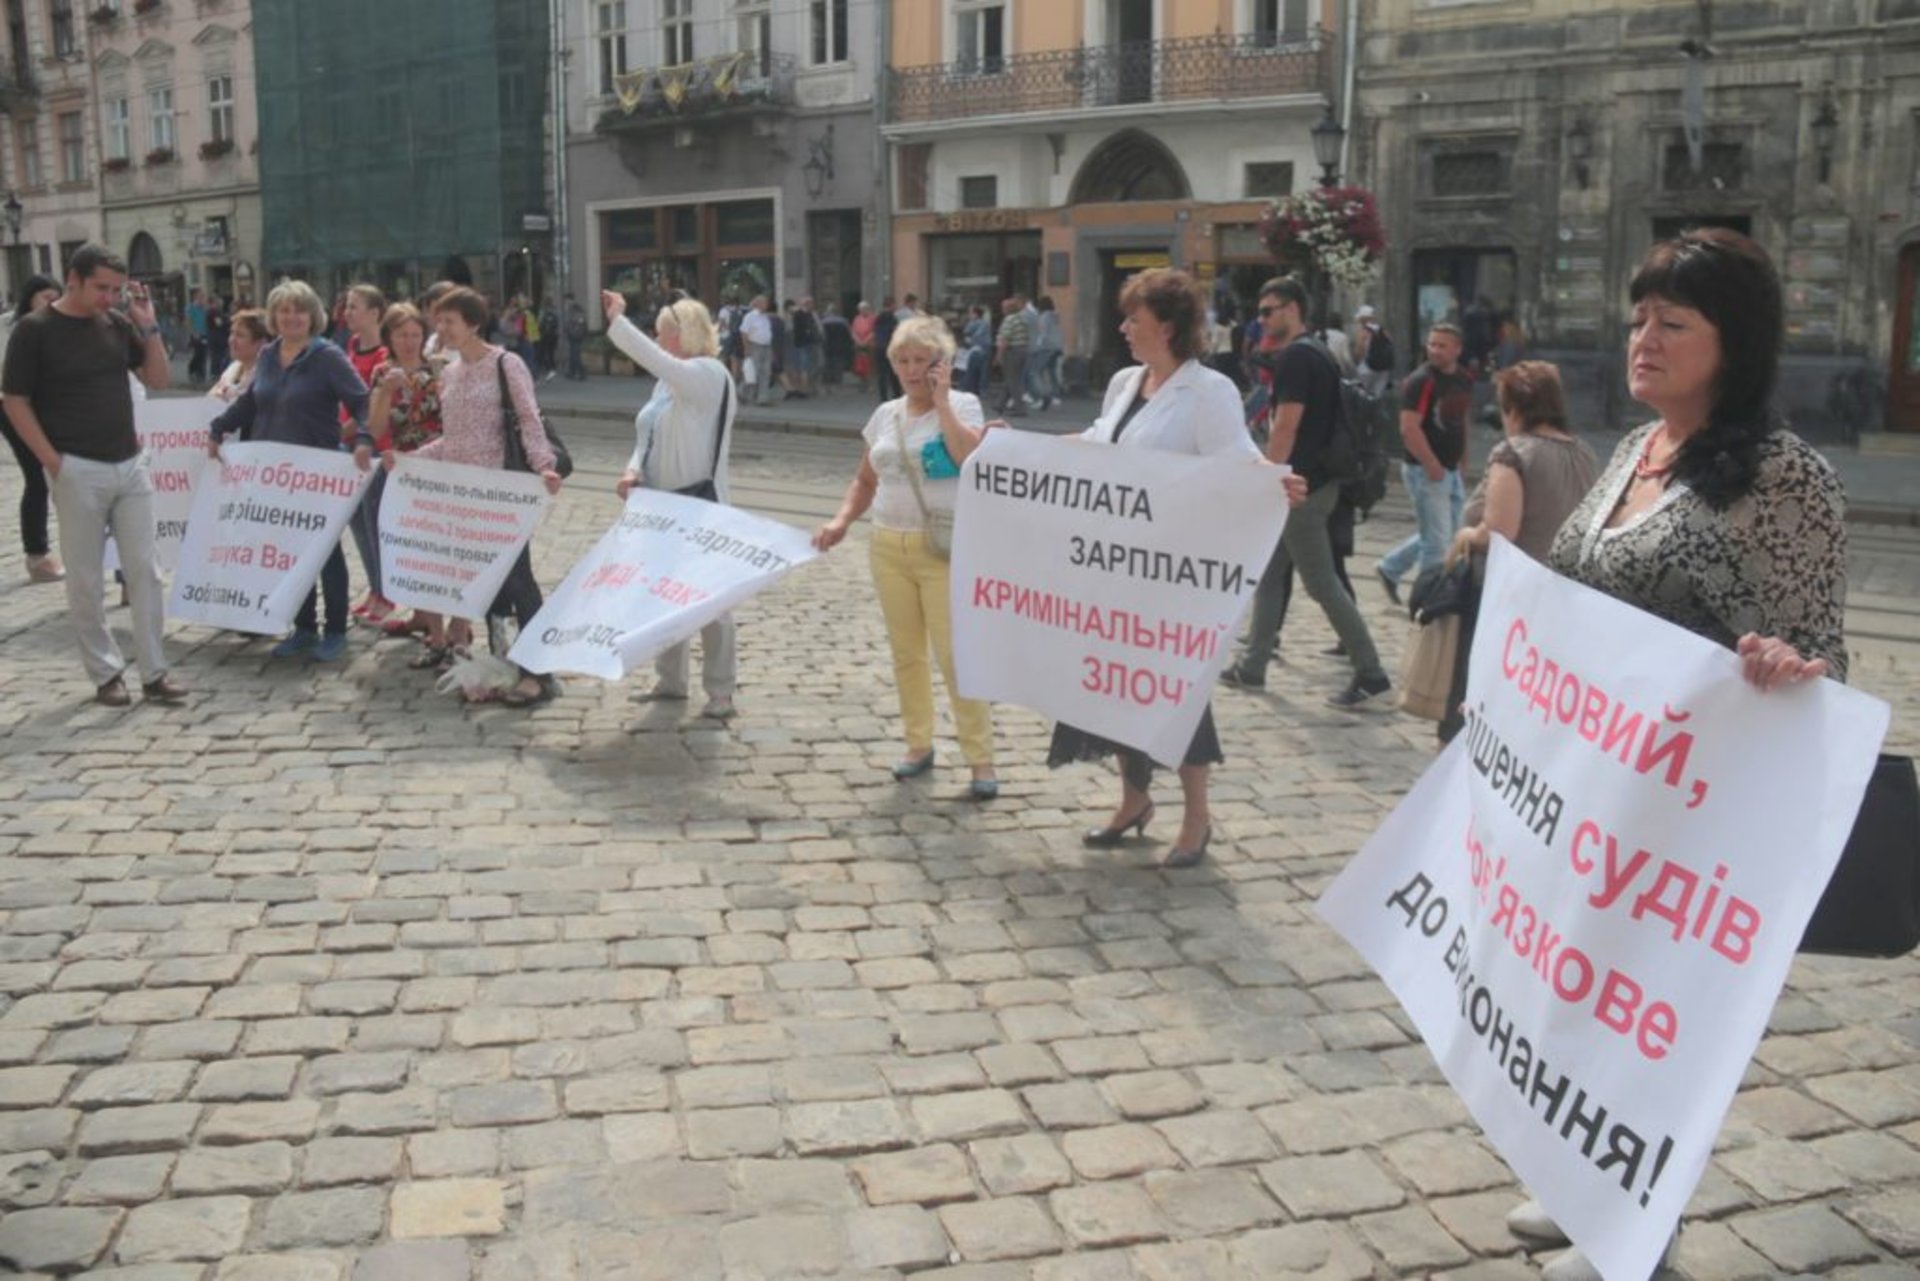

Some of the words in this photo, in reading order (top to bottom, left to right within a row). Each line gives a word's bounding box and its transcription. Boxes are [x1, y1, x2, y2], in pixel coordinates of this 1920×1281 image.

[974, 461, 1154, 523] НЕВИПЛАТА
[1069, 535, 1258, 596] ЗАРПЛАТИ-
[1081, 655, 1193, 706] ЗЛОЧ
[1502, 616, 1709, 809] Садовий,
[1386, 871, 1450, 938] до
[1569, 819, 1763, 965] судів
